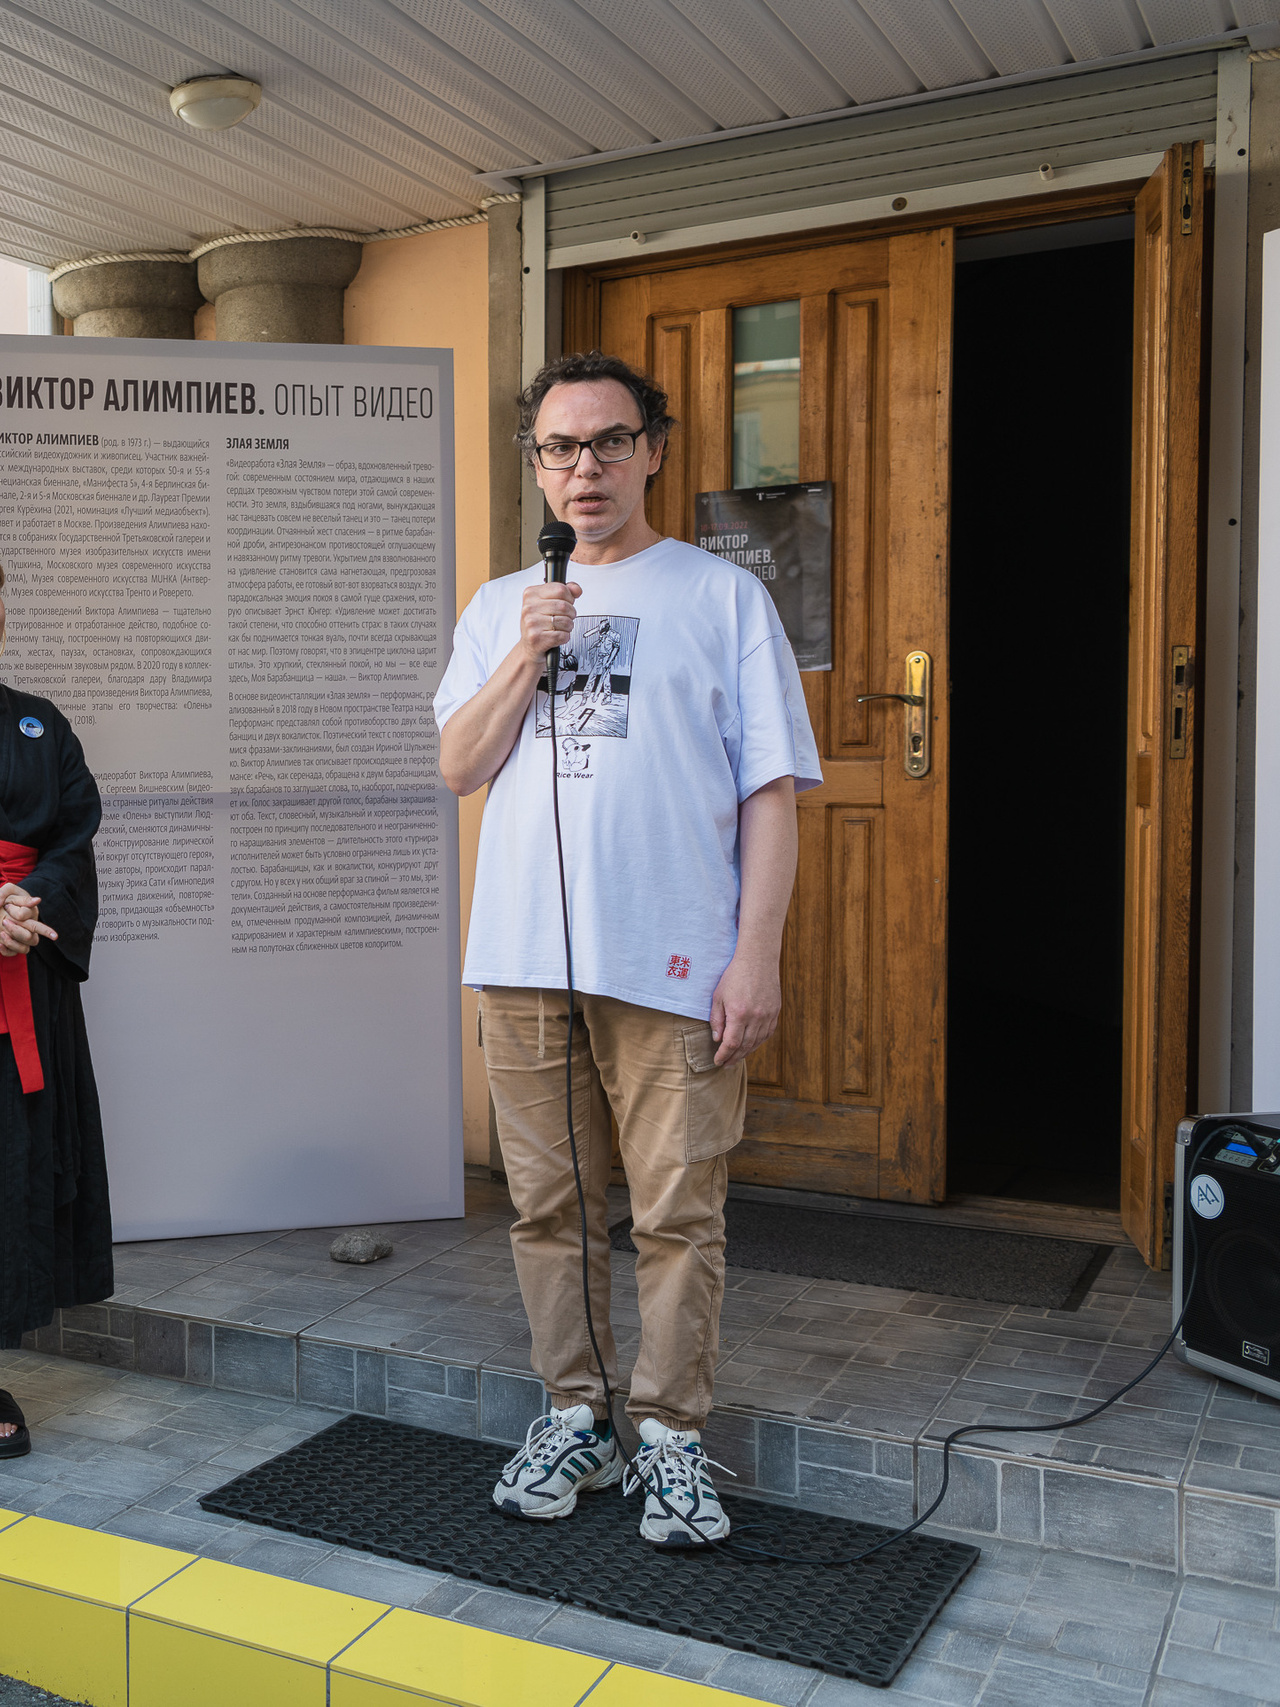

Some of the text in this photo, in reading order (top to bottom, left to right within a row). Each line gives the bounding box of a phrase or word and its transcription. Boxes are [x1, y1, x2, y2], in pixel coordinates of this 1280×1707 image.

[104, 380, 265, 415] АЛИМПИЕВ.
[275, 384, 345, 417] ОПЫТ
[354, 387, 433, 421] ВИДЕО
[36, 434, 99, 446] АЛИМПИЕВ
[101, 437, 119, 448] (род.
[128, 438, 142, 447] 1973
[163, 438, 210, 448] выдающийся
[226, 438, 289, 450] ЗЛАЯ ЗЕМЛЯ
[34, 451, 91, 461] видеохудожник
[100, 452, 142, 462] живописец.
[144, 451, 177, 460] Участник
[179, 452, 209, 461] важней-
[7, 464, 69, 474] международных
[72, 466, 107, 475] выставок,
[110, 466, 132, 475] среди
[136, 467, 165, 476] которых
[168, 466, 184, 474] 50-я
[195, 466, 209, 475] 55-я
[226, 457, 434, 472] «Видеоработа «Злая Земля» образ, вдохновленный трево-
[43, 476, 80, 488] биеннале,
[83, 477, 128, 489] «Манифеста
[130, 478, 139, 489] 5»,
[141, 478, 152, 487] 4-я
[154, 479, 196, 490] Берлинская
[197, 480, 209, 488] би-
[226, 471, 239, 480] гой:
[242, 473, 291, 483] современным
[337, 475, 357, 484] мира,
[360, 476, 403, 485] отдающимся
[19, 490, 31, 499] 2-я
[38, 490, 50, 499] 5-я
[52, 490, 94, 500] Московская
[96, 491, 131, 500] биеннале
[138, 494, 149, 503] др.
[151, 492, 180, 503] Лауреат
[181, 493, 210, 504] Премии
[226, 486, 434, 499] сердцах тревожным чувством потери этой самой современ-
[17, 504, 51, 515] Курёхина
[54, 504, 74, 515] (2021,
[76, 507, 118, 516] номинация
[120, 505, 152, 516] «Лучший
[154, 506, 210, 517] медиаобъект»).
[251, 498, 263, 507] Это
[265, 500, 288, 510] земля,
[290, 499, 340, 510] вздыбившаяся
[342, 502, 355, 510] под
[357, 502, 384, 511] ногами,
[386, 502, 435, 512] вынуждающая
[22, 517, 56, 528] работает
[63, 518, 92, 527] Москве.
[94, 518, 147, 530] Произведения
[148, 519, 189, 528] Алимпиева
[18, 531, 57, 542] собраниях
[58, 532, 120, 543] Государственной
[122, 533, 174, 544] Третьяковской
[175, 535, 204, 544] галереи
[700, 534, 748, 550] ВИКТОР
[227, 607, 241, 616] рую
[284, 606, 304, 616] Эрнст
[307, 606, 331, 616] Юнгер:
[335, 606, 375, 616] «Удивление
[402, 608, 436, 617] достигать
[228, 674, 249, 683] здесь,
[250, 672, 265, 681] Моя
[266, 672, 314, 683] Барабанщица
[358, 672, 382, 682] Виктор
[382, 672, 419, 680] Алимпиев.
[139, 768, 213, 780] Виктора Алимпиева,
[106, 782, 213, 794] Сергеем Вишневским (видео-
[111, 796, 213, 808] странные ритуалы действия
[103, 836, 213, 848] «Конструирование лирической
[105, 851, 214, 862] вокруг отсутствующего героя»,
[231, 912, 439, 929] ем, отмеченным продуманной композицией, динамичным
[231, 931, 286, 942] кадрированием
[296, 929, 341, 939] характерным
[344, 926, 403, 937] «алимпиевским»,
[405, 925, 439, 935] построен-
[258, 944, 294, 954] полутонах
[295, 940, 338, 950] сближенных
[340, 941, 363, 951] цветов
[364, 940, 403, 950] колоритом.
